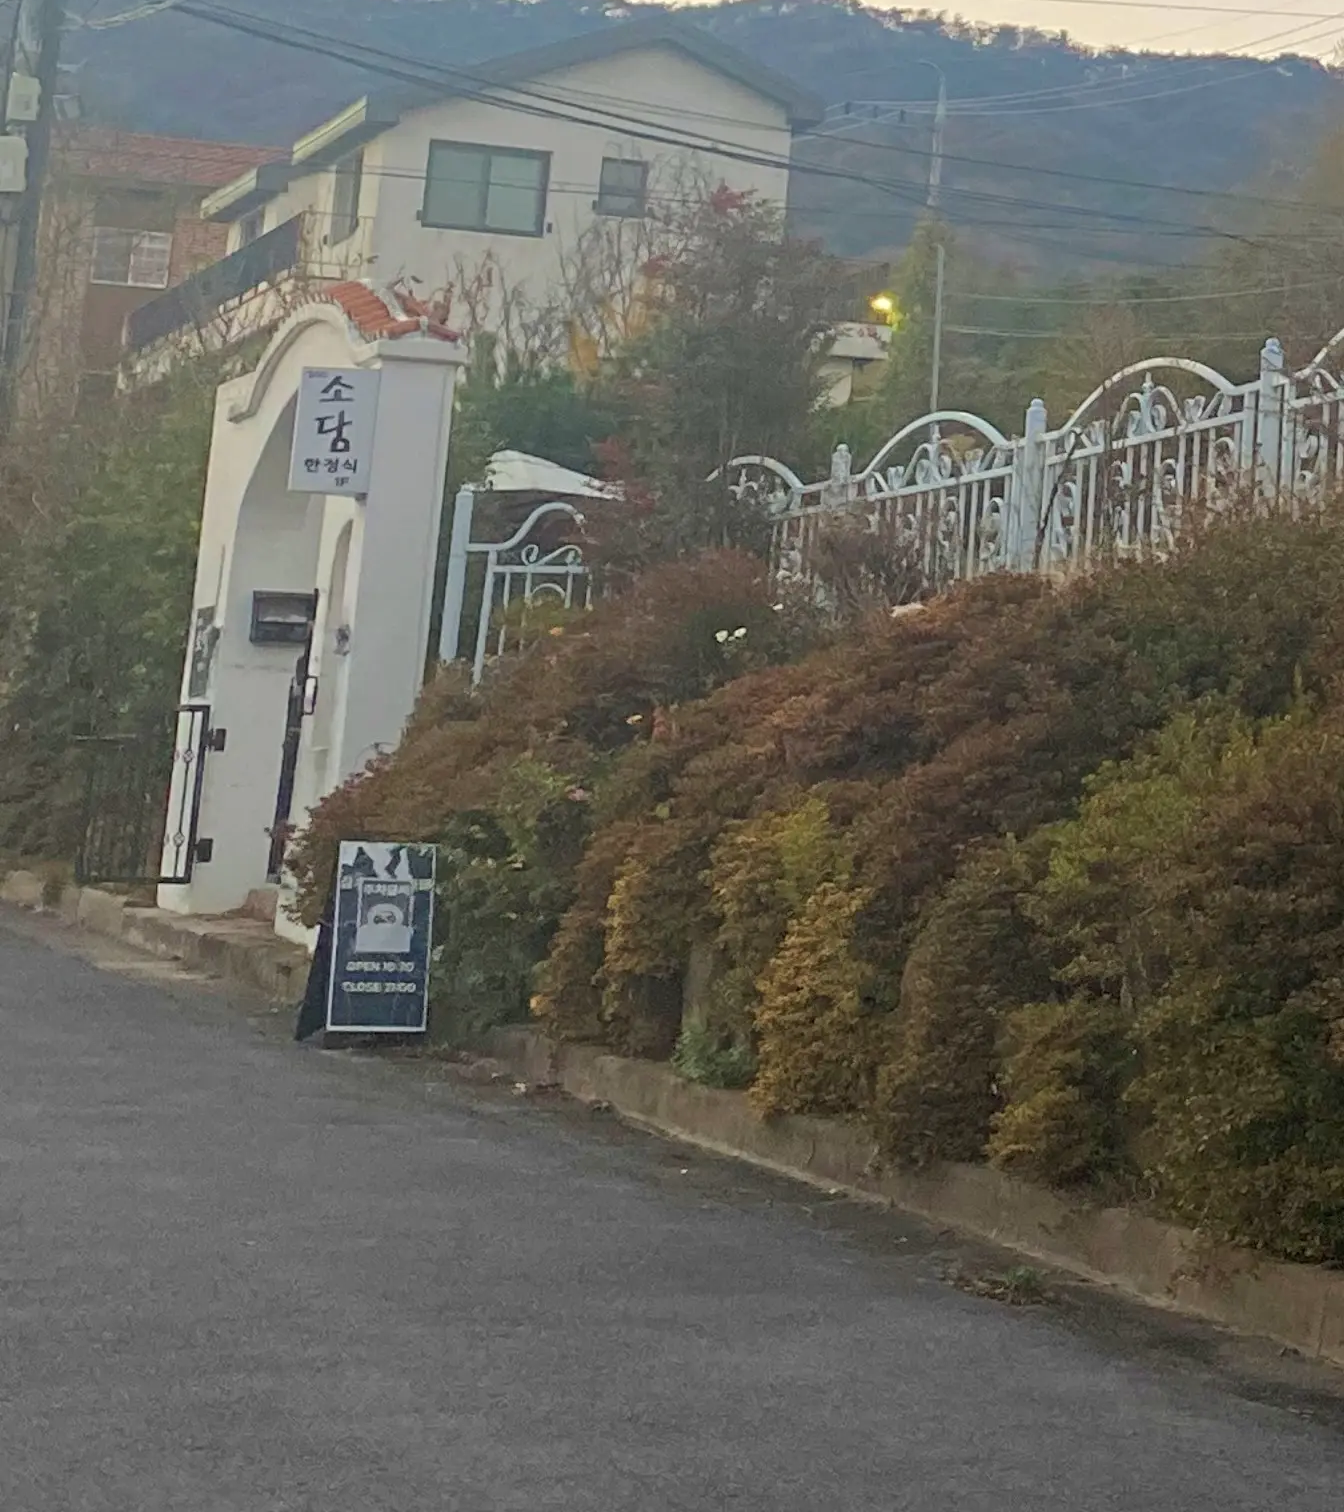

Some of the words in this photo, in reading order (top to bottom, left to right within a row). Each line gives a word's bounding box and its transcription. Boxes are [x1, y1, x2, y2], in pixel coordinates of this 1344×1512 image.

[314, 375, 355, 453] 소담
[304, 457, 358, 474] 한정식
[334, 476, 350, 487] 1F
[345, 961, 381, 972] OPEN
[341, 981, 382, 993] CLOSE
